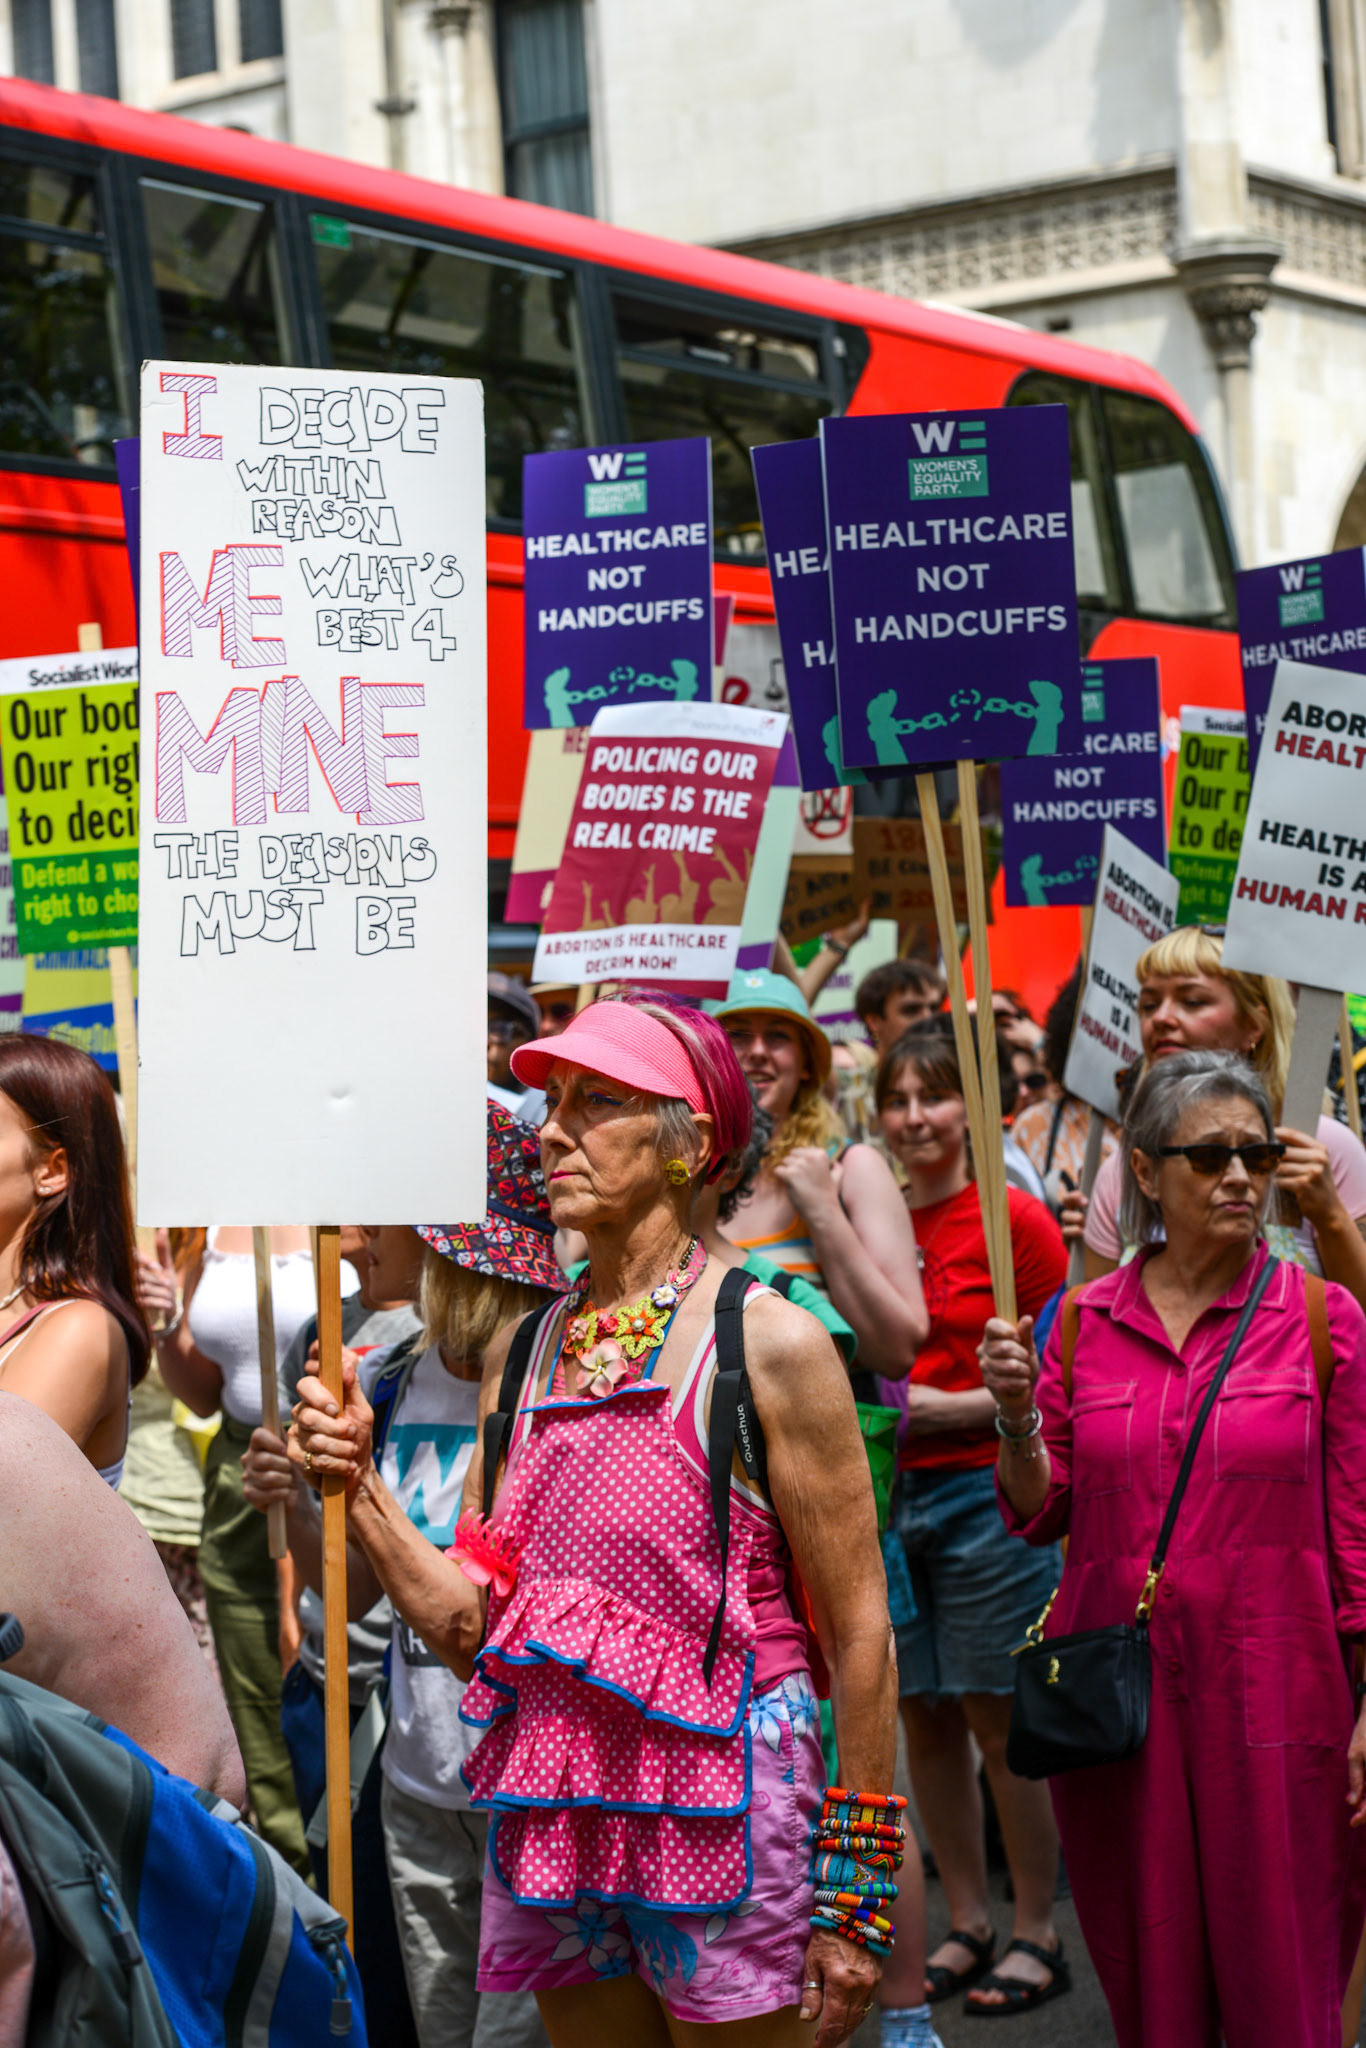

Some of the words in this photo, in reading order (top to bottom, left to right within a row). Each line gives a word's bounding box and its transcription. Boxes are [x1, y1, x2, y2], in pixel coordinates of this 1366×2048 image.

[160, 372, 223, 460] I
[259, 387, 445, 453] DECIDE
[236, 455, 386, 502] WITHIN
[913, 459, 978, 472] WOMEN'S
[914, 470, 982, 484] EQUALITY
[914, 483, 962, 496] PARTY.
[252, 499, 401, 545] REASON
[834, 511, 1068, 551] HEALTHCARE
[526, 522, 707, 560] HEALTHCARE
[587, 565, 647, 592] NOT
[774, 547, 829, 578] HE
[916, 563, 990, 593] NOT
[160, 544, 286, 668] ME
[300, 552, 464, 605] WHAT'S
[538, 598, 704, 632] HANDCUFFS
[854, 605, 1067, 643] HANDCUFFS
[317, 609, 404, 652] BEST
[412, 608, 456, 661] 4
[1242, 626, 1366, 668] HEALTHCARE
[802, 640, 836, 668] H
[29, 663, 99, 687] Socialist
[10, 698, 67, 741] Our
[80, 687, 139, 734] bod
[1281, 700, 1366, 739] ABOR
[156, 676, 425, 826] MINE
[591, 746, 699, 775] POLICING
[702, 749, 758, 781] OUR
[1185, 736, 1229, 770] Our
[1275, 729, 1366, 769] HEALT
[14, 751, 73, 794] Our
[1054, 767, 1105, 788] NOT
[582, 783, 667, 811] BODIES
[670, 786, 695, 813] IS
[702, 788, 752, 820] THE
[1013, 798, 1157, 823] HANDCUFFS
[1181, 775, 1226, 810] Our
[18, 805, 53, 846] to
[573, 822, 632, 849] REAL
[637, 823, 717, 855] CRIME
[1179, 816, 1203, 848] to
[1213, 818, 1240, 851] de
[1259, 819, 1366, 862] HEALTH
[22, 858, 90, 889] Defend
[95, 863, 107, 883] a
[154, 831, 238, 879] THE
[260, 833, 437, 887] DECISIONS
[1317, 863, 1345, 888] IS
[24, 893, 72, 925] right
[77, 891, 99, 916] to
[1108, 862, 1163, 920] ABORTION
[1237, 877, 1347, 920] HUMAN
[181, 889, 324, 956] MUST
[356, 896, 416, 955] BE
[545, 937, 611, 956] ABORTION
[614, 933, 625, 948] IS
[629, 932, 727, 949] HEALTHCARE
[585, 956, 634, 975] DECRIM
[638, 956, 677, 970] NOW!
[1080, 1010, 1120, 1056] HUMAN
[1111, 1005, 1121, 1028] IS
[1122, 1015, 1131, 1034] A
[737, 1404, 753, 1463] Quechua
